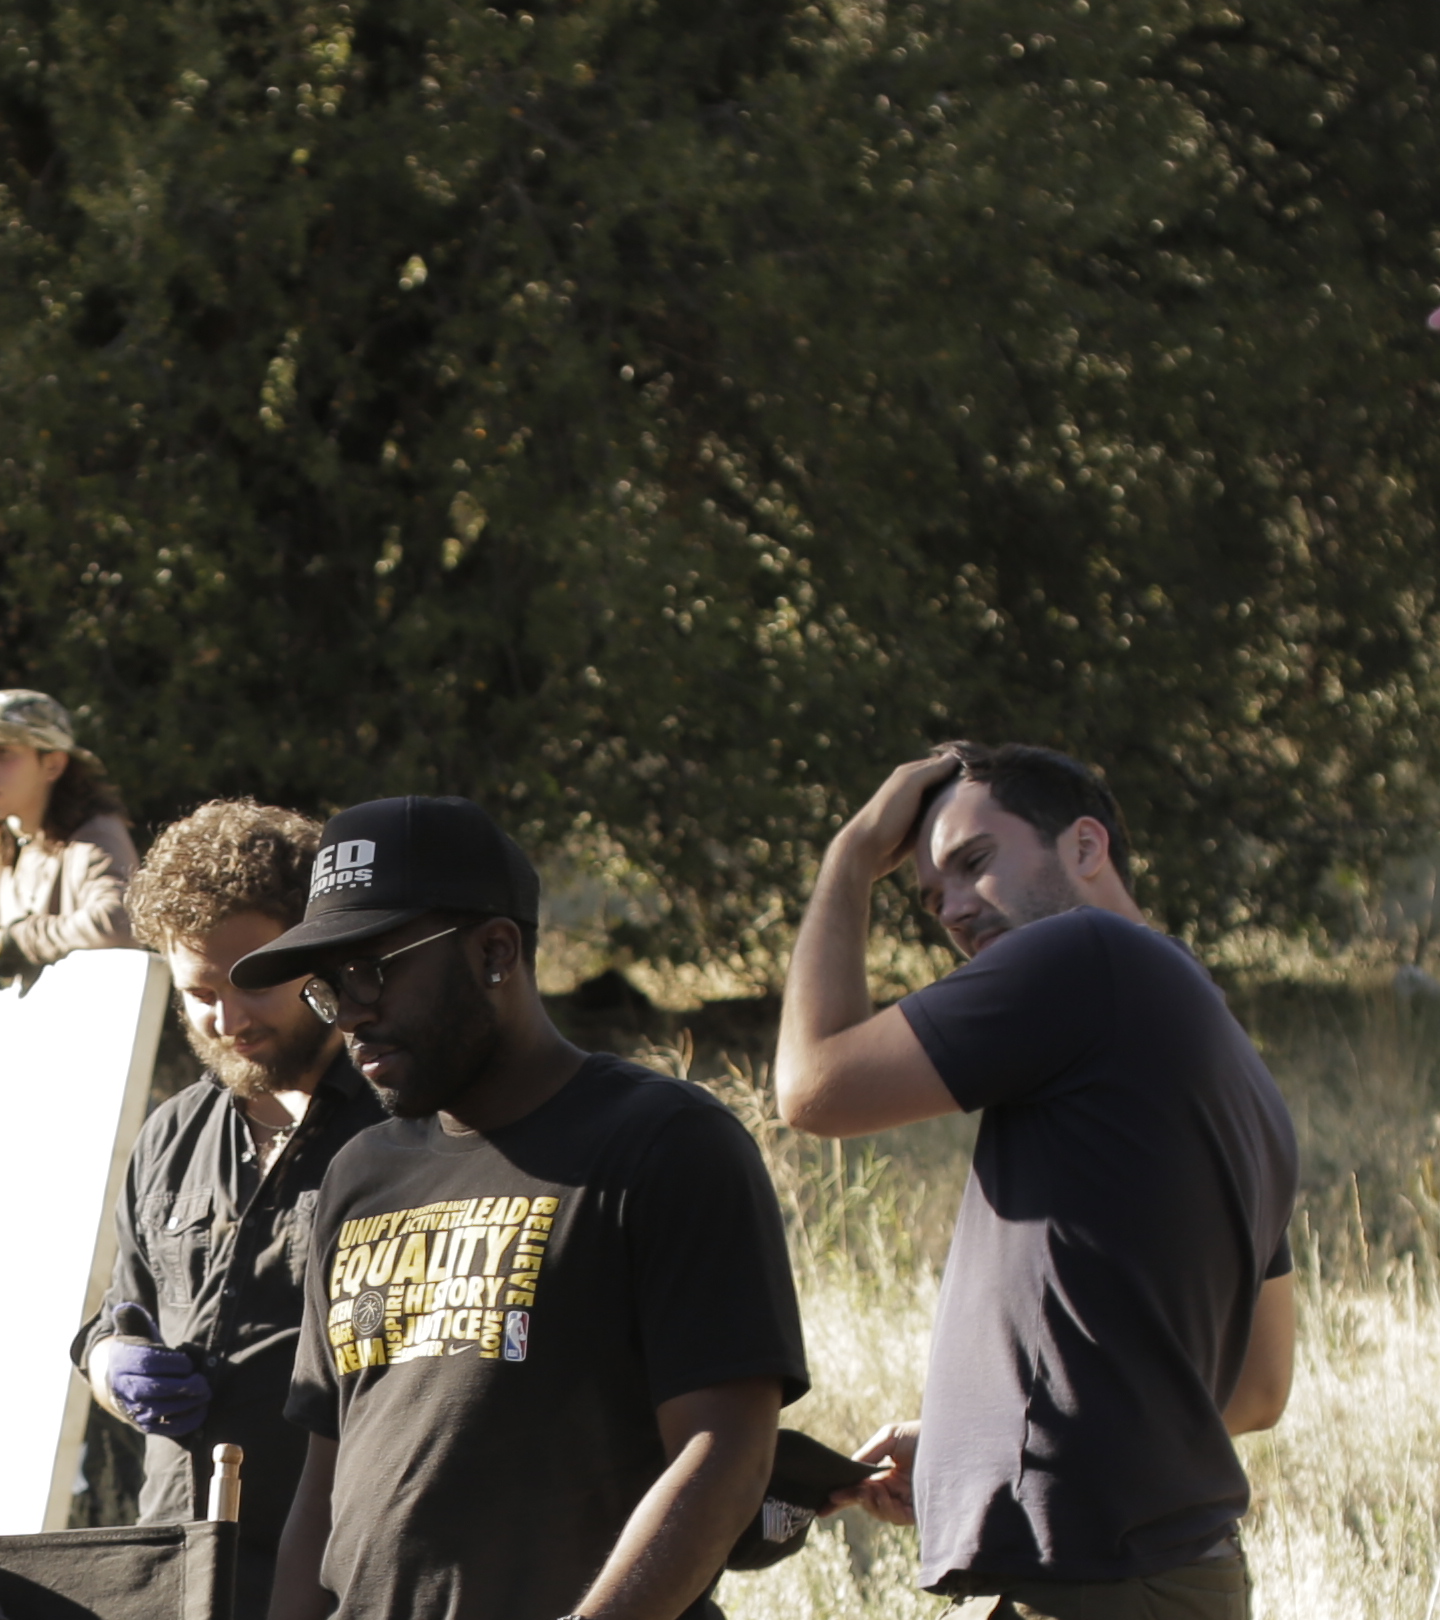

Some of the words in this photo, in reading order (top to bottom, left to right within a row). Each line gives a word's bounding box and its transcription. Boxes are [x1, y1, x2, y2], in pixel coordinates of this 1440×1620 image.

[338, 1209, 408, 1250] UNIFY
[398, 1211, 465, 1236] ACTIVATE
[461, 1197, 530, 1226] LEAD
[329, 1226, 520, 1301] EQUALITY
[504, 1196, 560, 1308] BELIEVE
[384, 1284, 406, 1365] INSPIRE
[479, 1309, 504, 1359] LOVE
